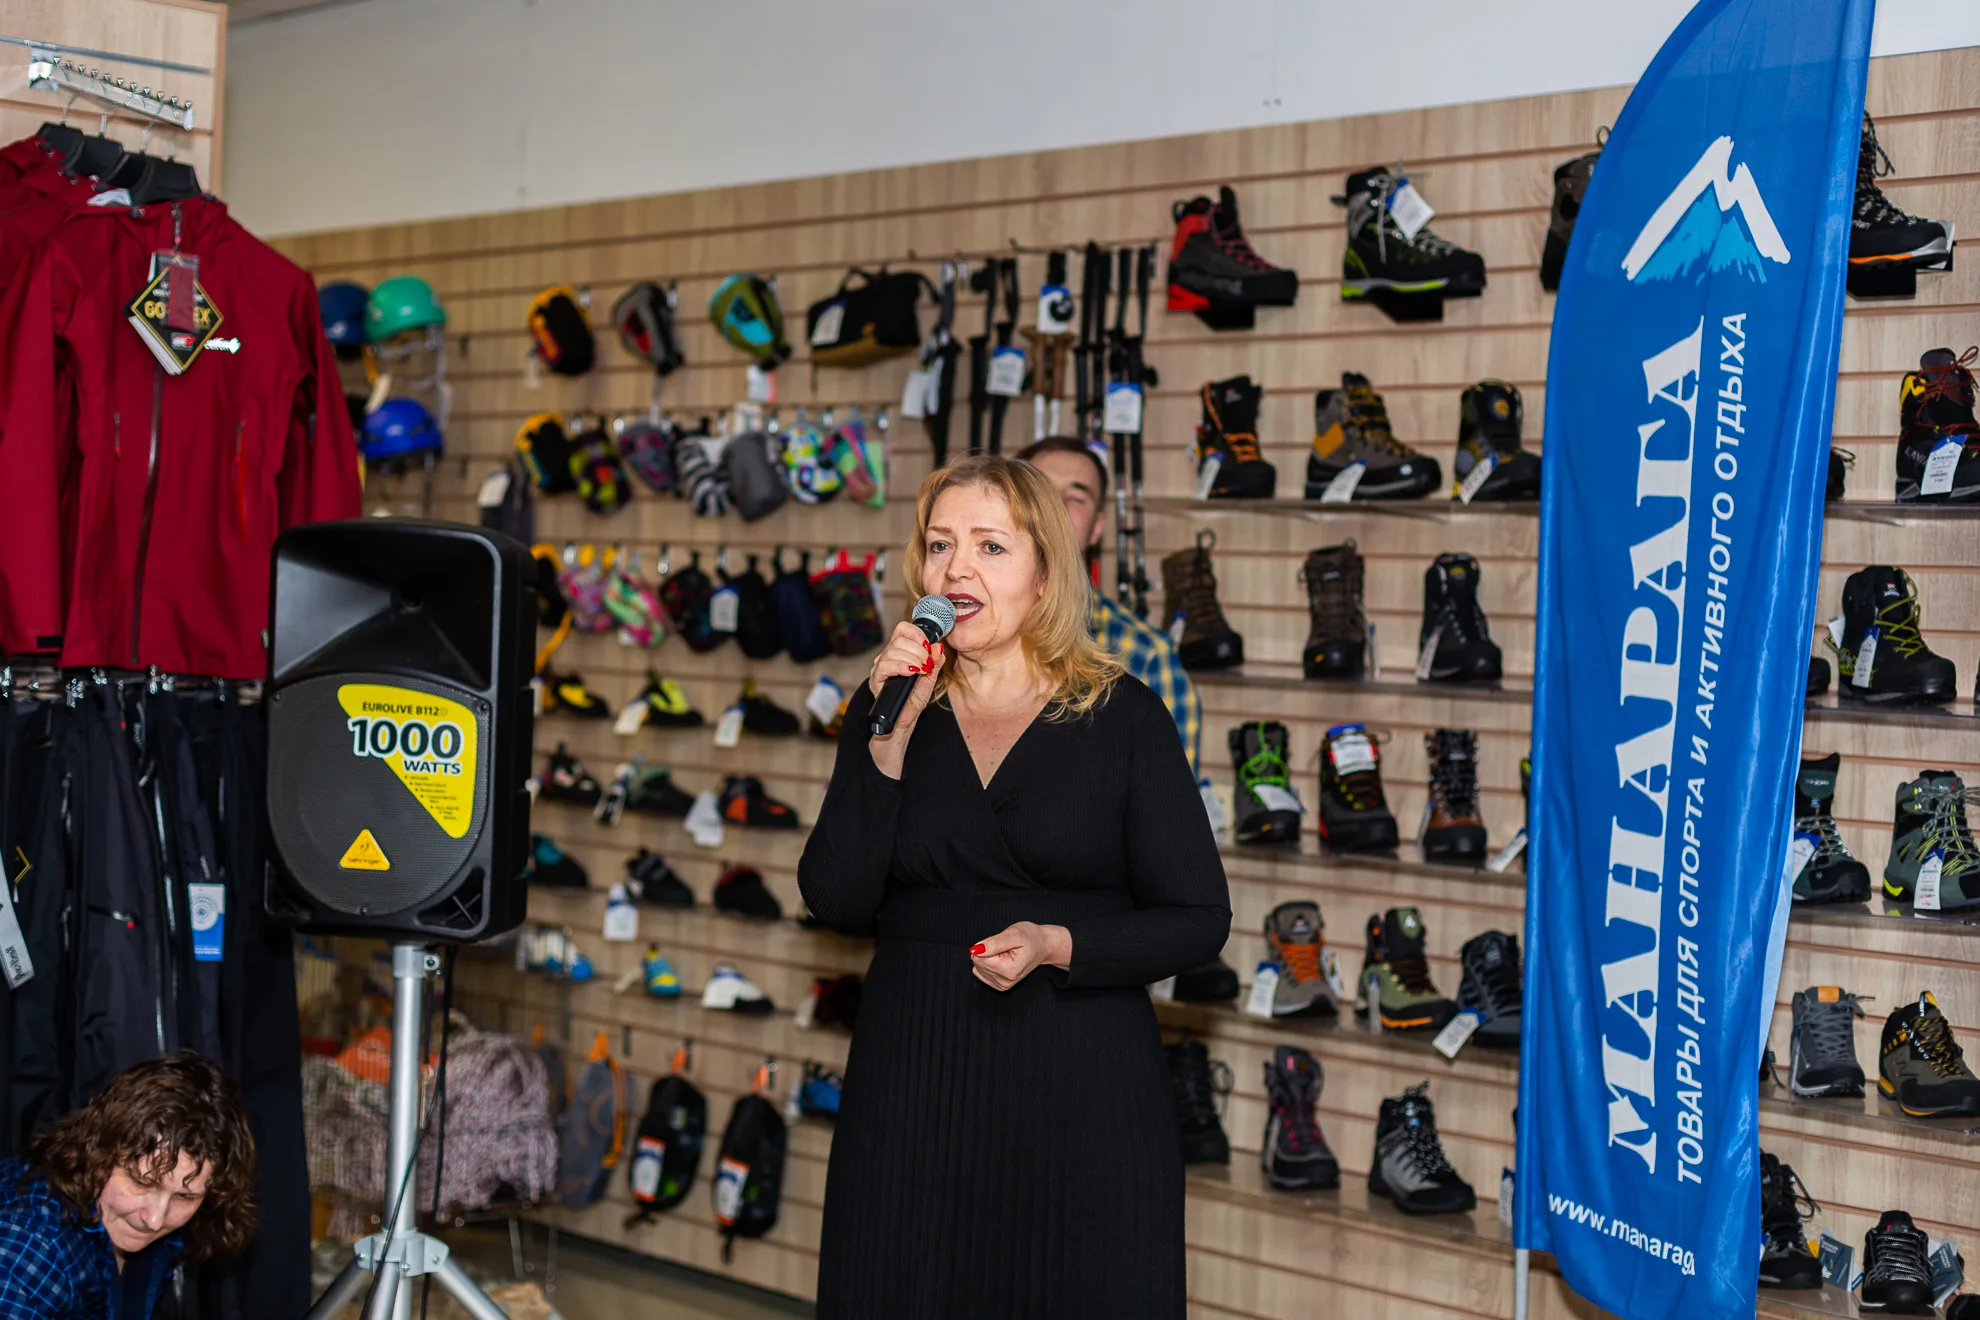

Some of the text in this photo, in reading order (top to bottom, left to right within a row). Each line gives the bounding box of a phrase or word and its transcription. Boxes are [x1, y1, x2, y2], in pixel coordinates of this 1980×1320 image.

[362, 701, 413, 715] EUROLIVE
[350, 718, 462, 760] 1000
[1601, 315, 1705, 1175] МАНАРАГА
[1677, 313, 1747, 1184] ТОВАРЫ ДЛЯ СПОРТА И АКТИВНОГО ОТДЫХА
[403, 759, 462, 775] WATTS
